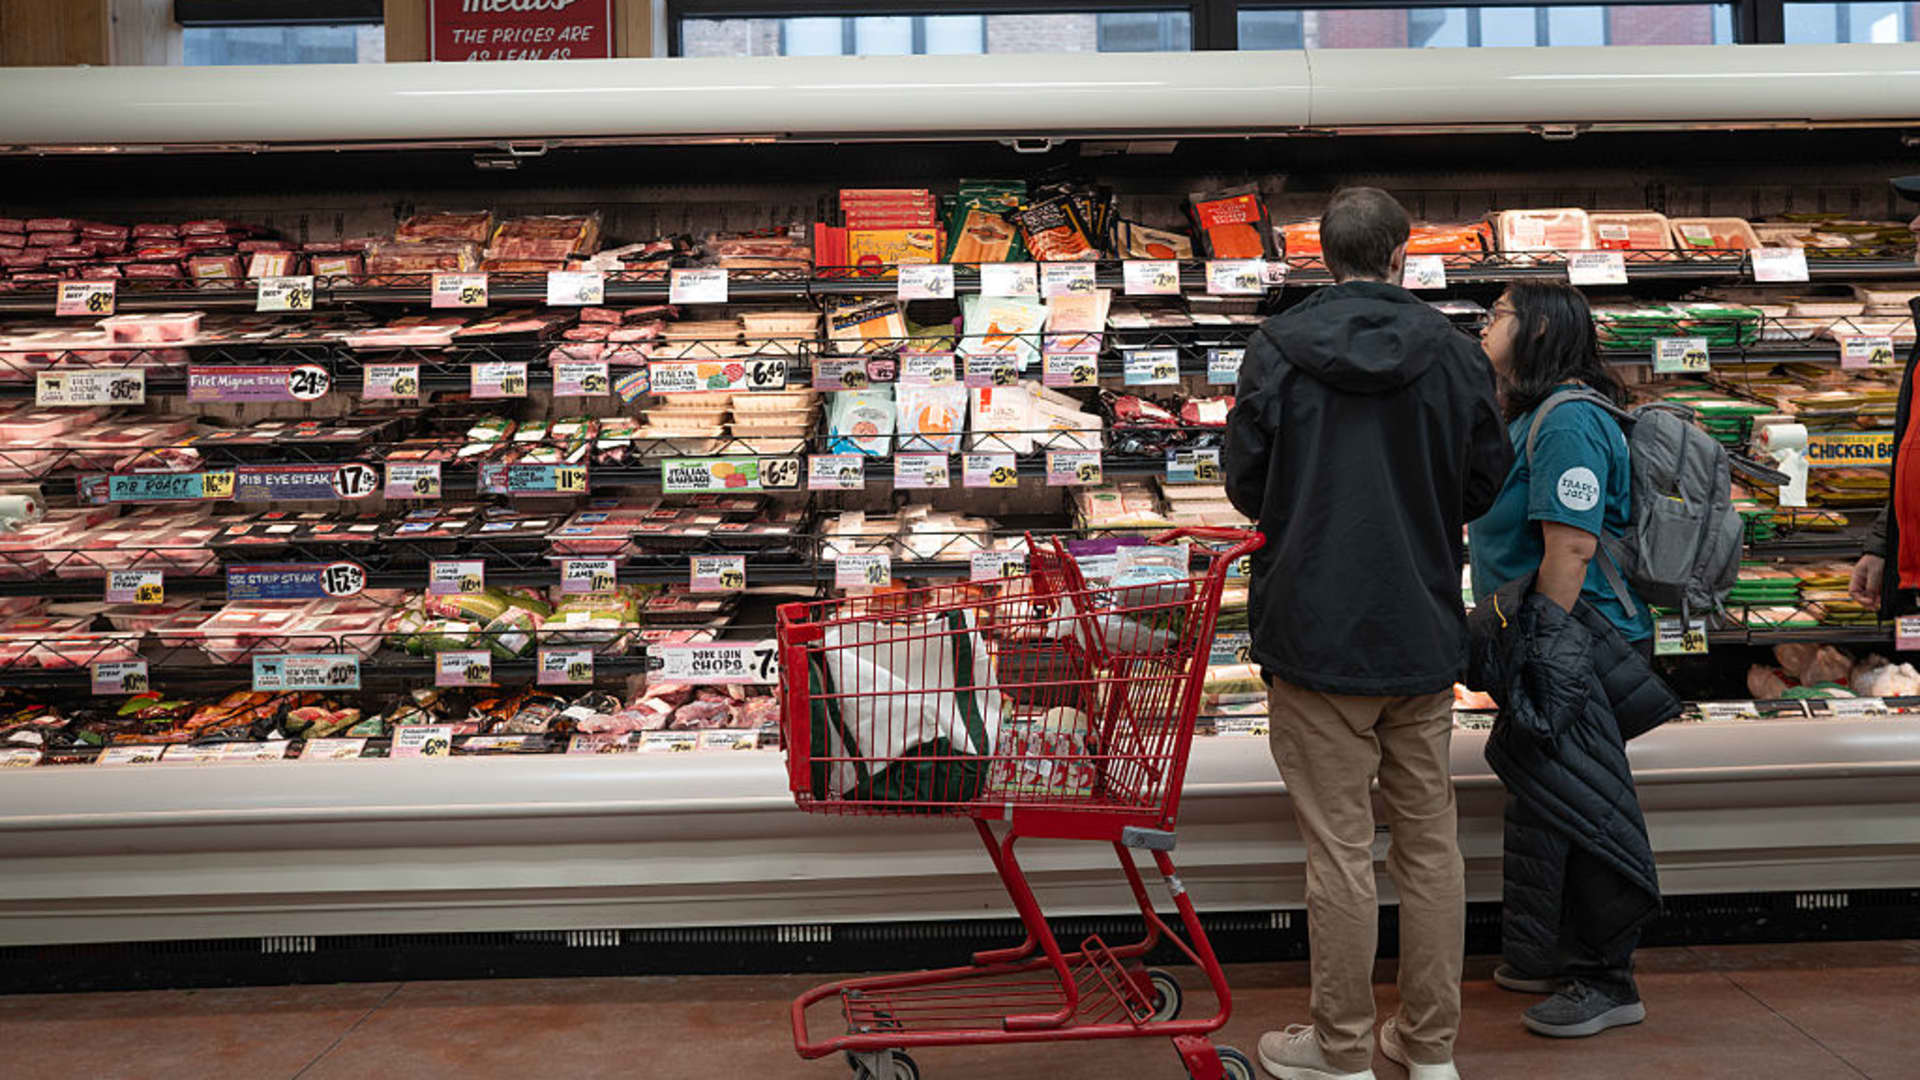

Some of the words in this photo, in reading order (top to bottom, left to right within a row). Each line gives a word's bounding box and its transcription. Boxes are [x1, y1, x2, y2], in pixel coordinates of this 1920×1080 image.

[453, 29, 486, 44] THE
[491, 27, 554, 43] PRICES
[557, 25, 594, 41] ARE
[467, 50, 490, 62] AS
[497, 49, 542, 61] LEAN
[548, 48, 572, 61] AS
[190, 374, 217, 388] Filet
[1808, 442, 1875, 460] CHICKEN
[669, 468, 710, 477] ITALIAN
[238, 474, 262, 486] RIB
[265, 474, 291, 485] EYE
[290, 473, 331, 485] STEAK
[667, 476, 711, 484] SAUSAGE
[248, 574, 279, 585] STRIP
[281, 573, 317, 583] STEAK
[568, 570, 594, 578] LAMB
[692, 650, 715, 660] PORK
[717, 649, 742, 660] LOIN
[691, 659, 744, 671] CHOPS
